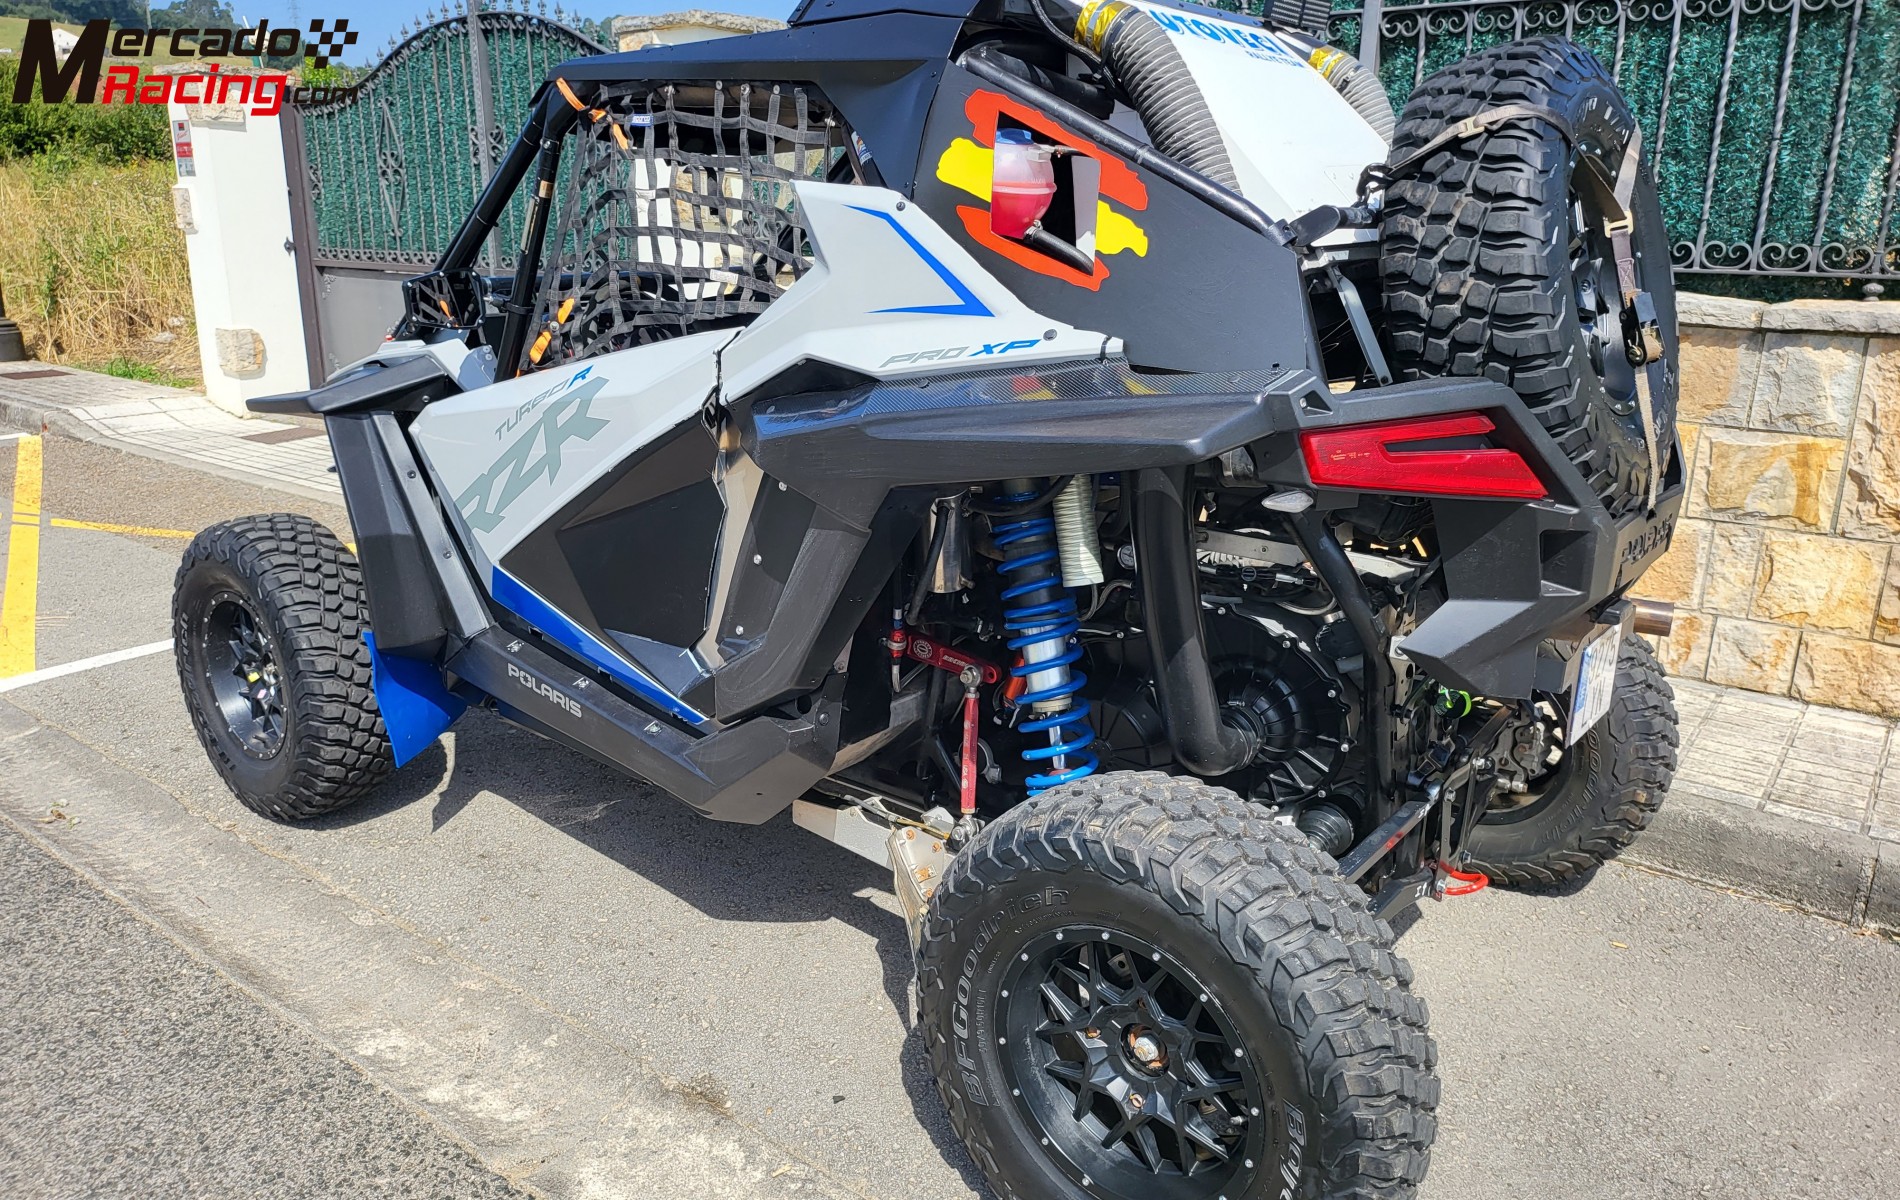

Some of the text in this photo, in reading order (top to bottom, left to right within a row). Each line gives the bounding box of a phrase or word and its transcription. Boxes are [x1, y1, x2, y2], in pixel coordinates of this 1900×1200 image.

[1149, 9, 1293, 58] UTOVECI
[879, 338, 1042, 369] PRO XP
[454, 376, 611, 536] RZR
[507, 662, 583, 719] POLARIS
